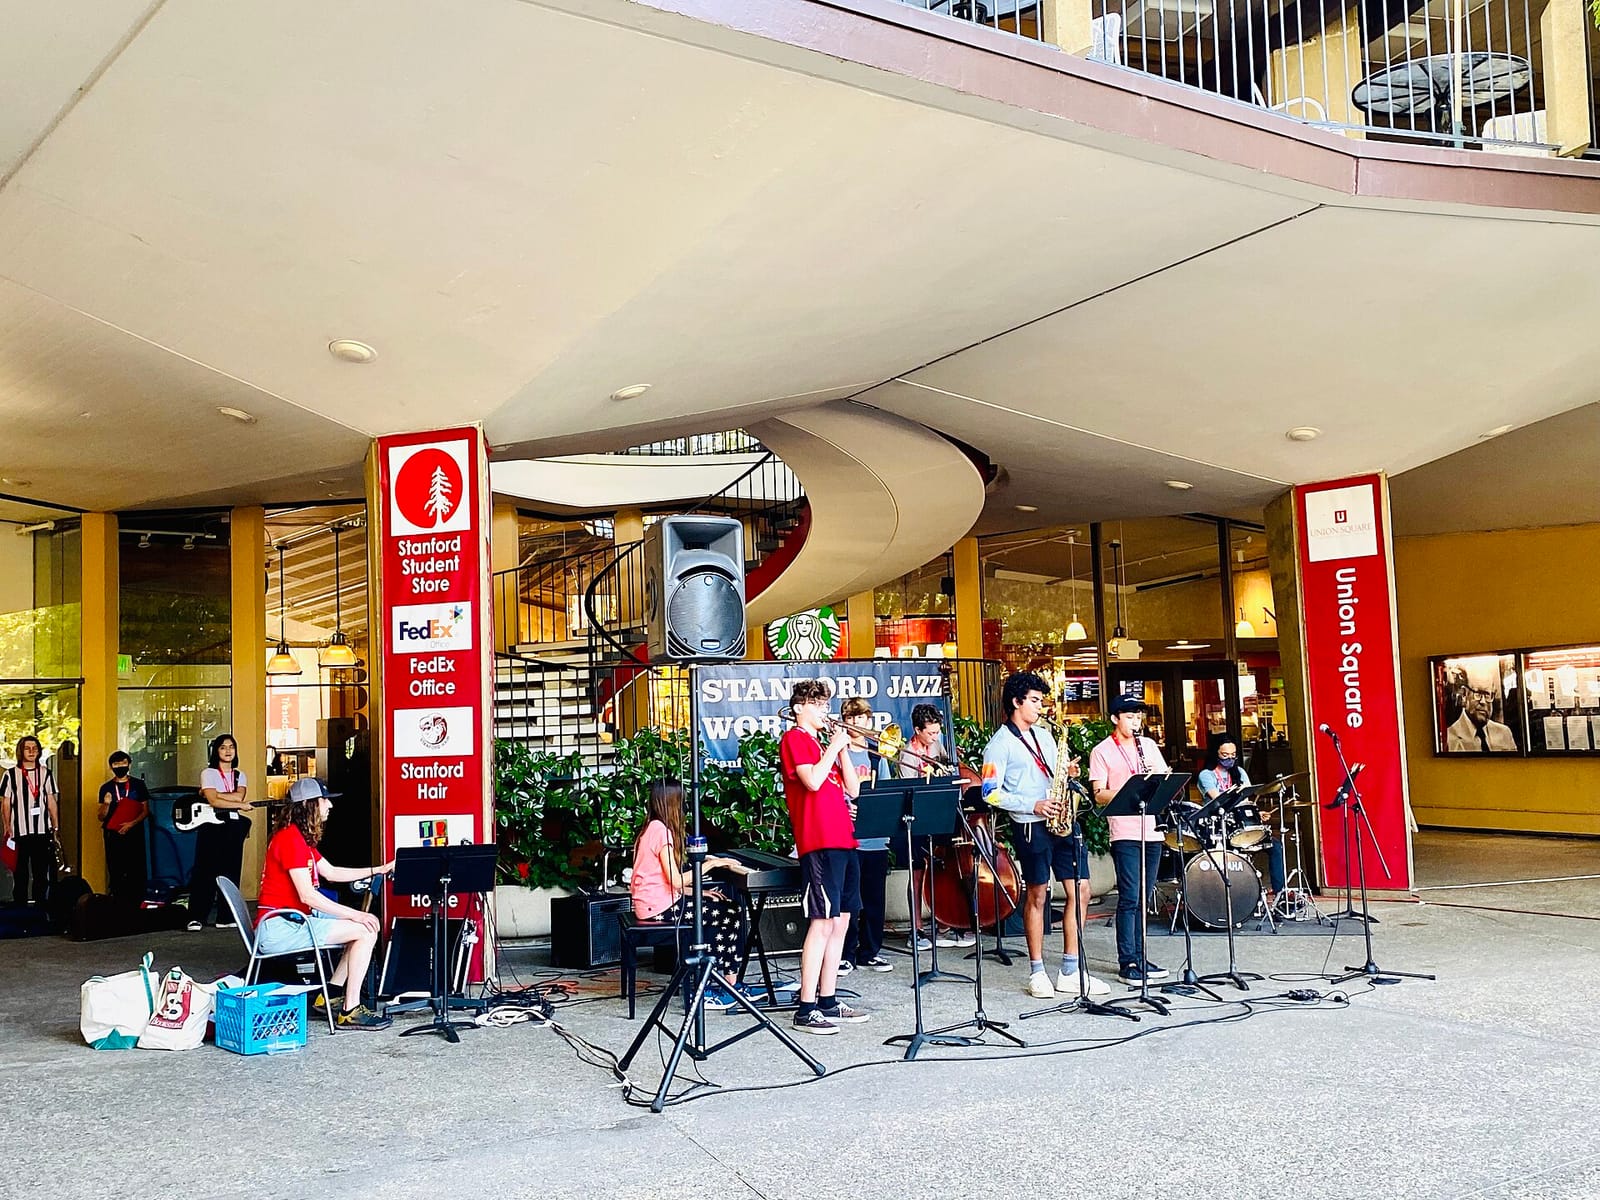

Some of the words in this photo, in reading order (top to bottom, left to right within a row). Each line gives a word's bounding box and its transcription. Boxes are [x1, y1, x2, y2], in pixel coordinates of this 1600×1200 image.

[1310, 528, 1338, 537] UNION
[1340, 523, 1372, 534] SQUARE
[398, 536, 461, 557] Stanford
[401, 555, 460, 575] Student
[411, 577, 450, 594] Store
[1335, 567, 1359, 635] Union
[399, 619, 453, 641] FedEx
[409, 657, 456, 674] FedEx
[409, 679, 456, 697] Office
[702, 677, 878, 703] STANORD
[886, 675, 943, 698] JAZZ
[1338, 642, 1363, 729] Square
[400, 761, 464, 780] Stanford
[417, 783, 448, 800] Hair
[411, 893, 459, 908] Hoe
